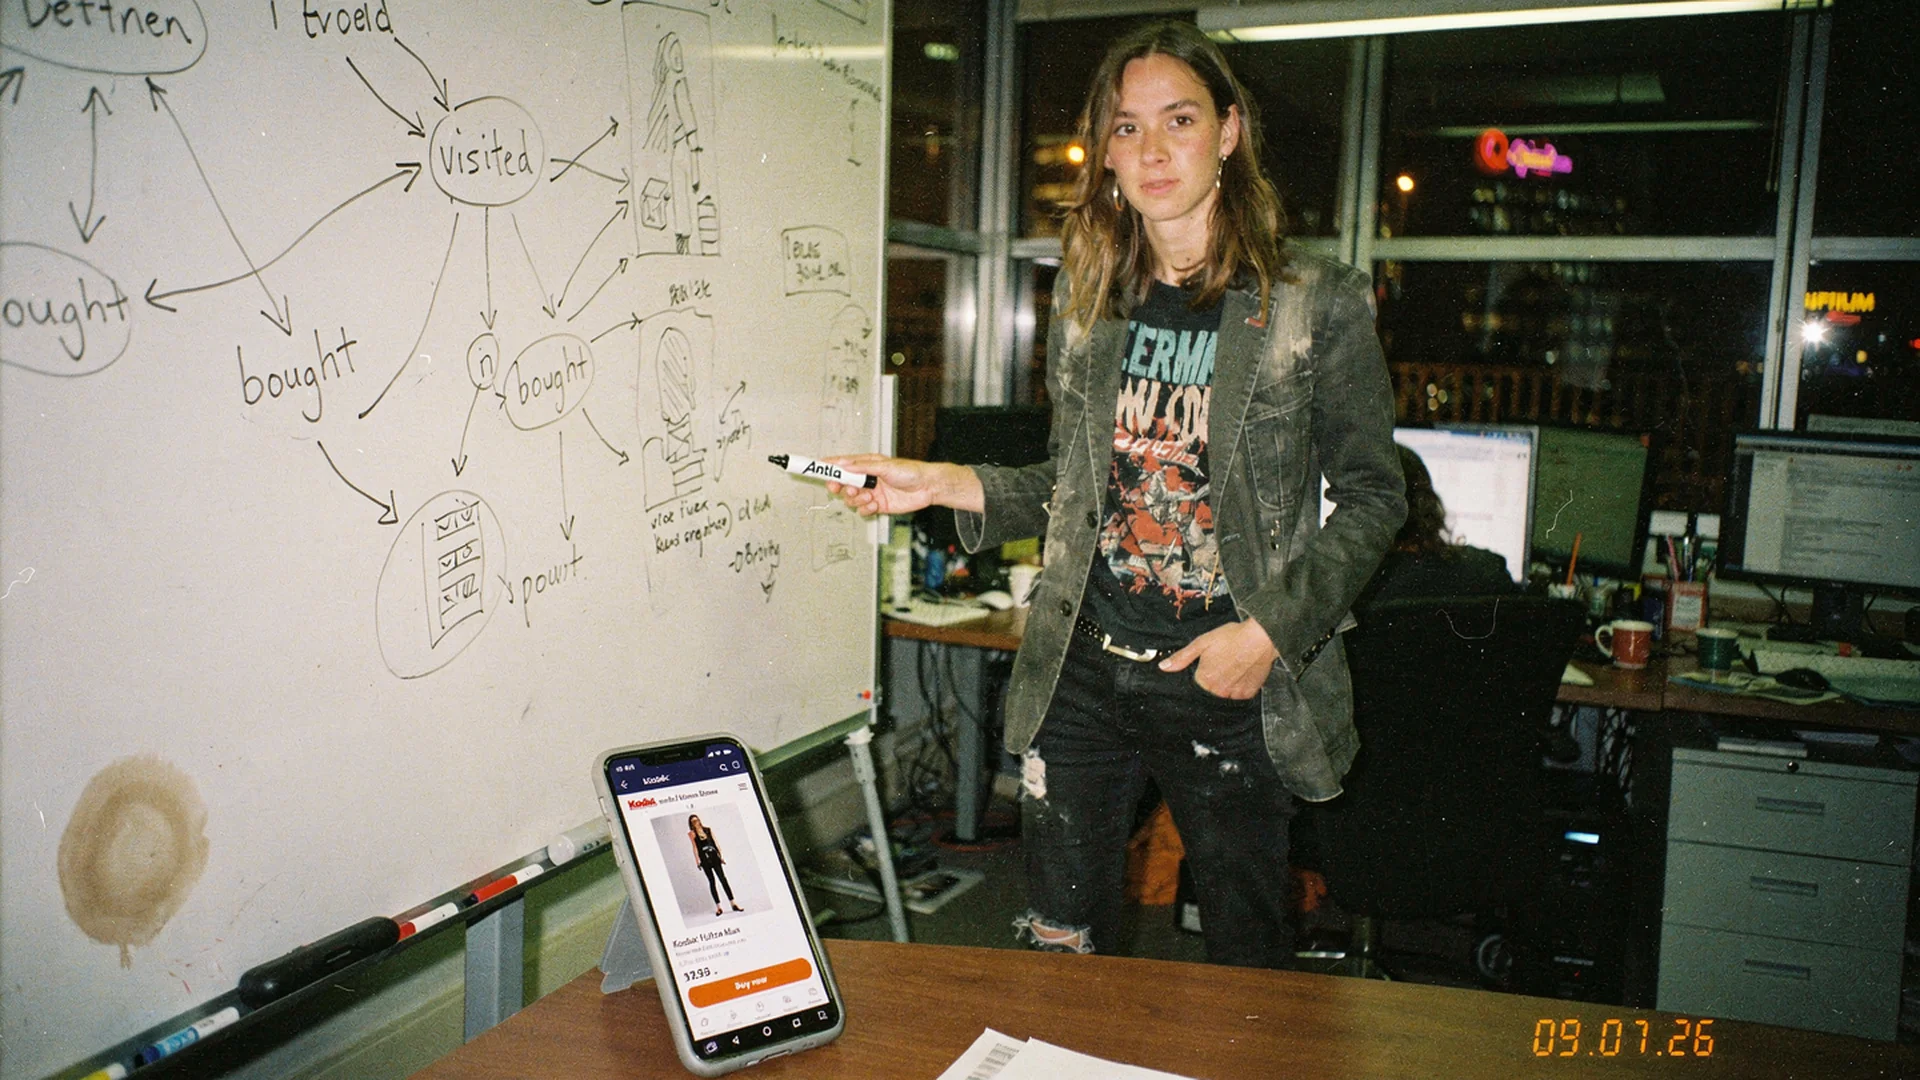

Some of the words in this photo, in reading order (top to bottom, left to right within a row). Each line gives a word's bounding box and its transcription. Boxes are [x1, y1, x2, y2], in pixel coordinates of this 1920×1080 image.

[440, 127, 533, 176] visited
[237, 326, 357, 423] bought
[514, 345, 588, 414] bought
